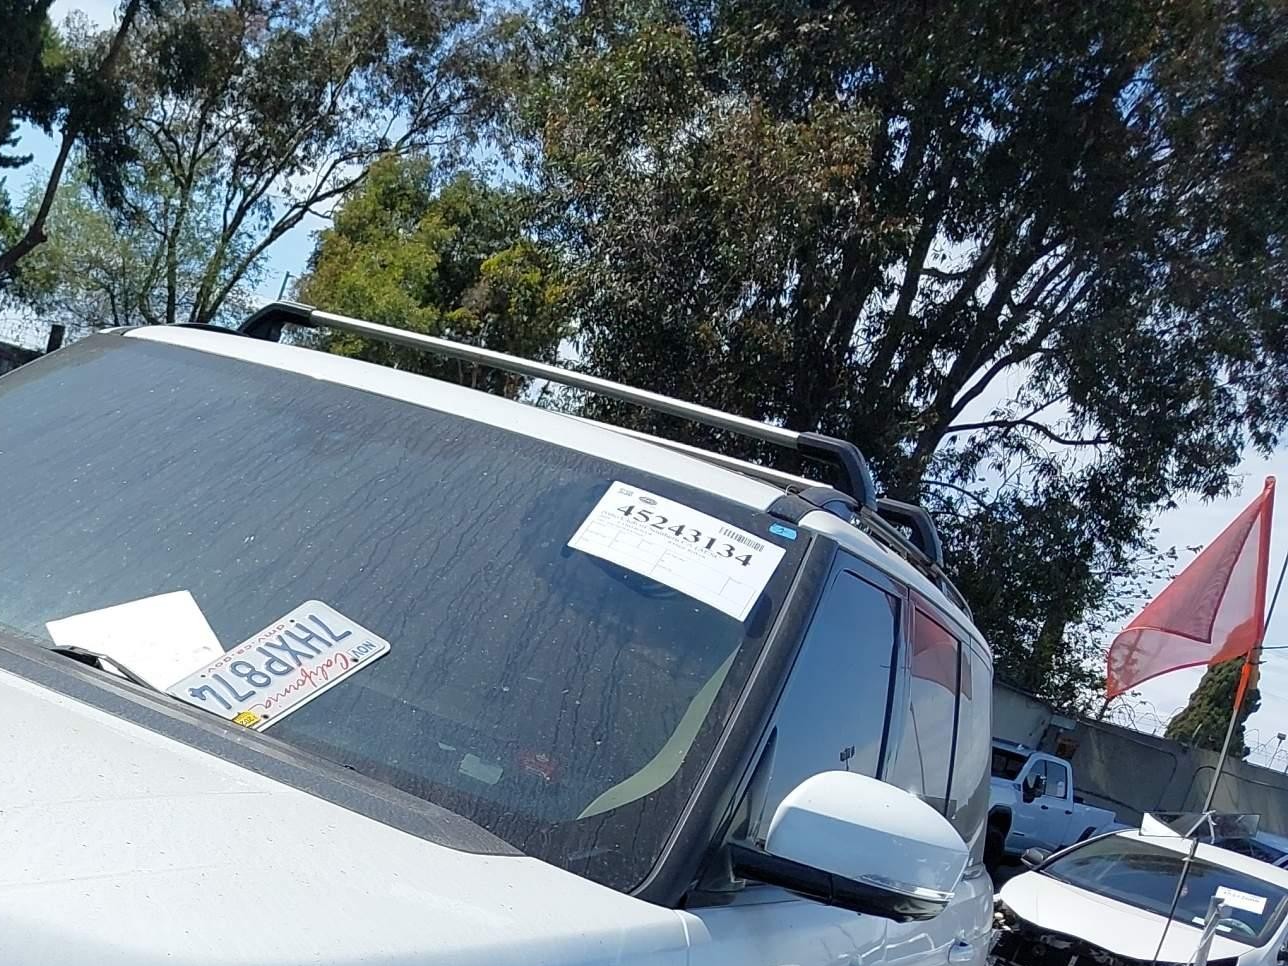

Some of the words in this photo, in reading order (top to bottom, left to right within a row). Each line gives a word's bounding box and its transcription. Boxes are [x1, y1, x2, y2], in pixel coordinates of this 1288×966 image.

[616, 505, 753, 567] 45243134
[188, 613, 353, 711] 7HXP874
[208, 623, 286, 674] dmv.ca.gov
[353, 640, 377, 659] NOV
[247, 651, 351, 712] California
